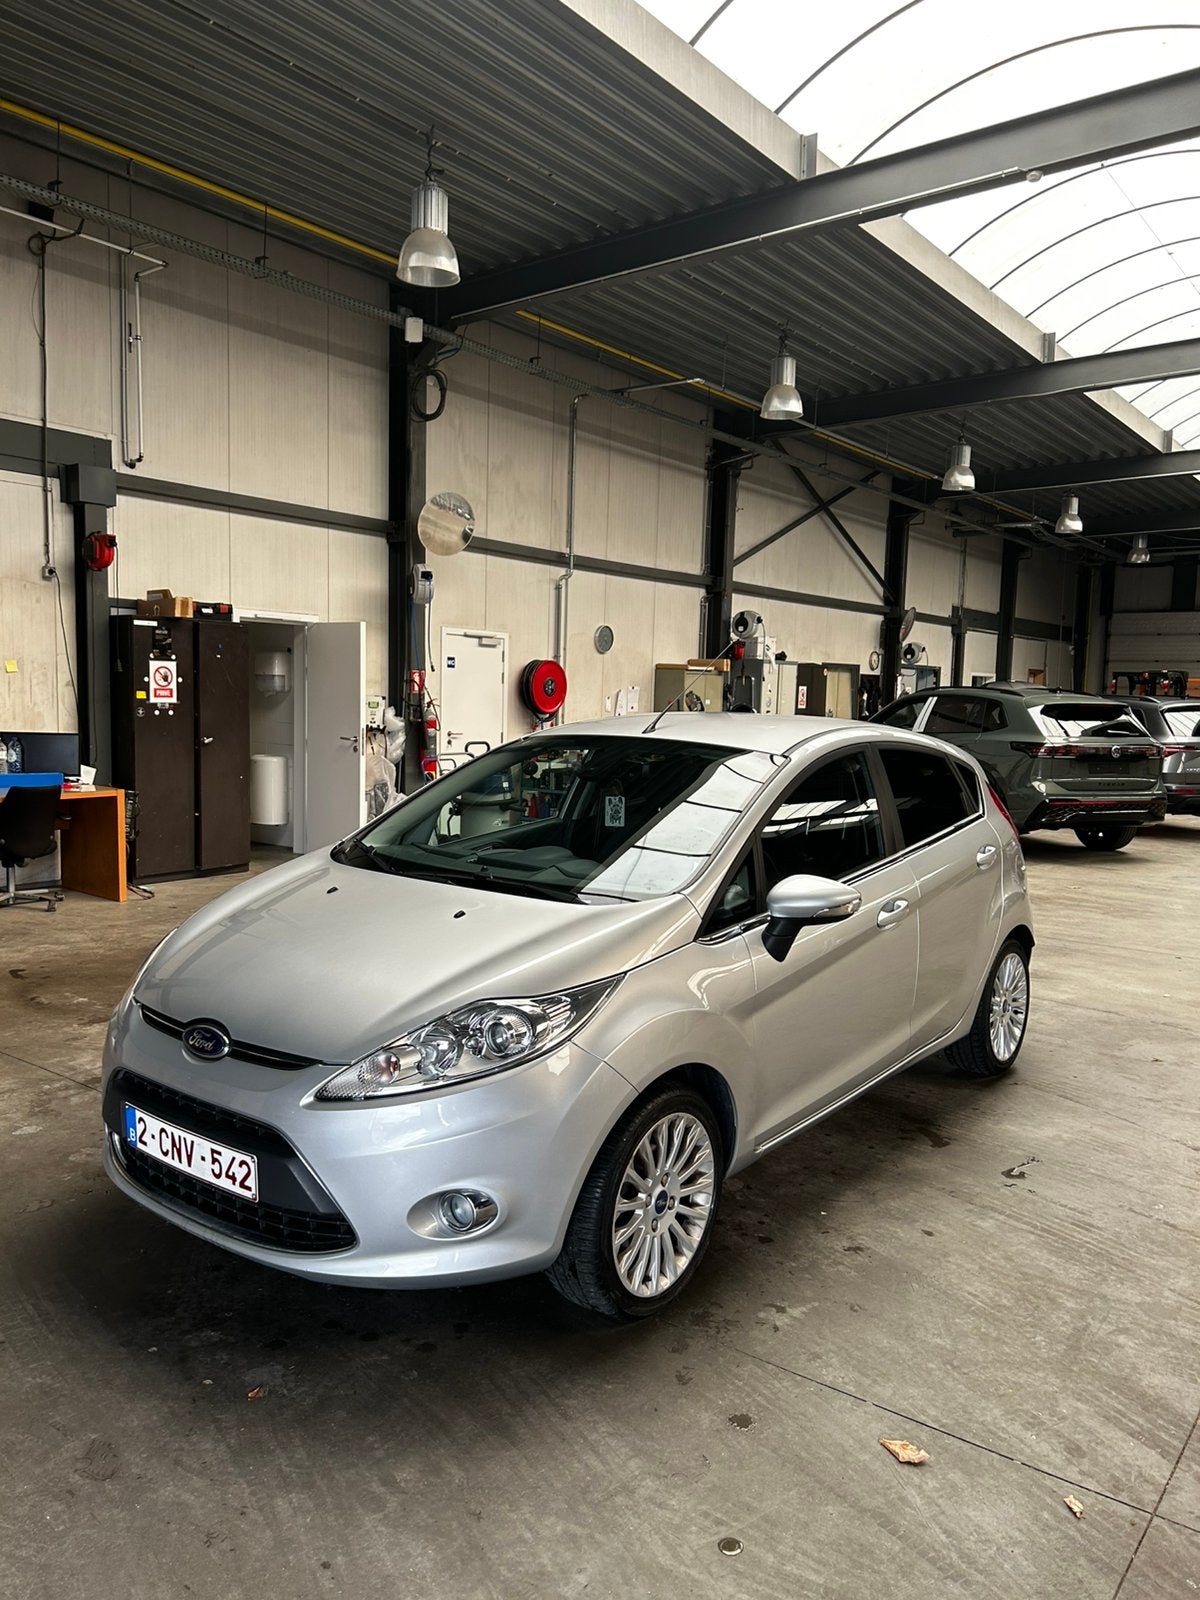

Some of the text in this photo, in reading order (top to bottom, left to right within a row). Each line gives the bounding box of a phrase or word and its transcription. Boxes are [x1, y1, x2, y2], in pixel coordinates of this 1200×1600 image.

[188, 1029, 217, 1050] Ford
[130, 1127, 136, 1142] B
[137, 1116, 252, 1192] 2-CNV-542
